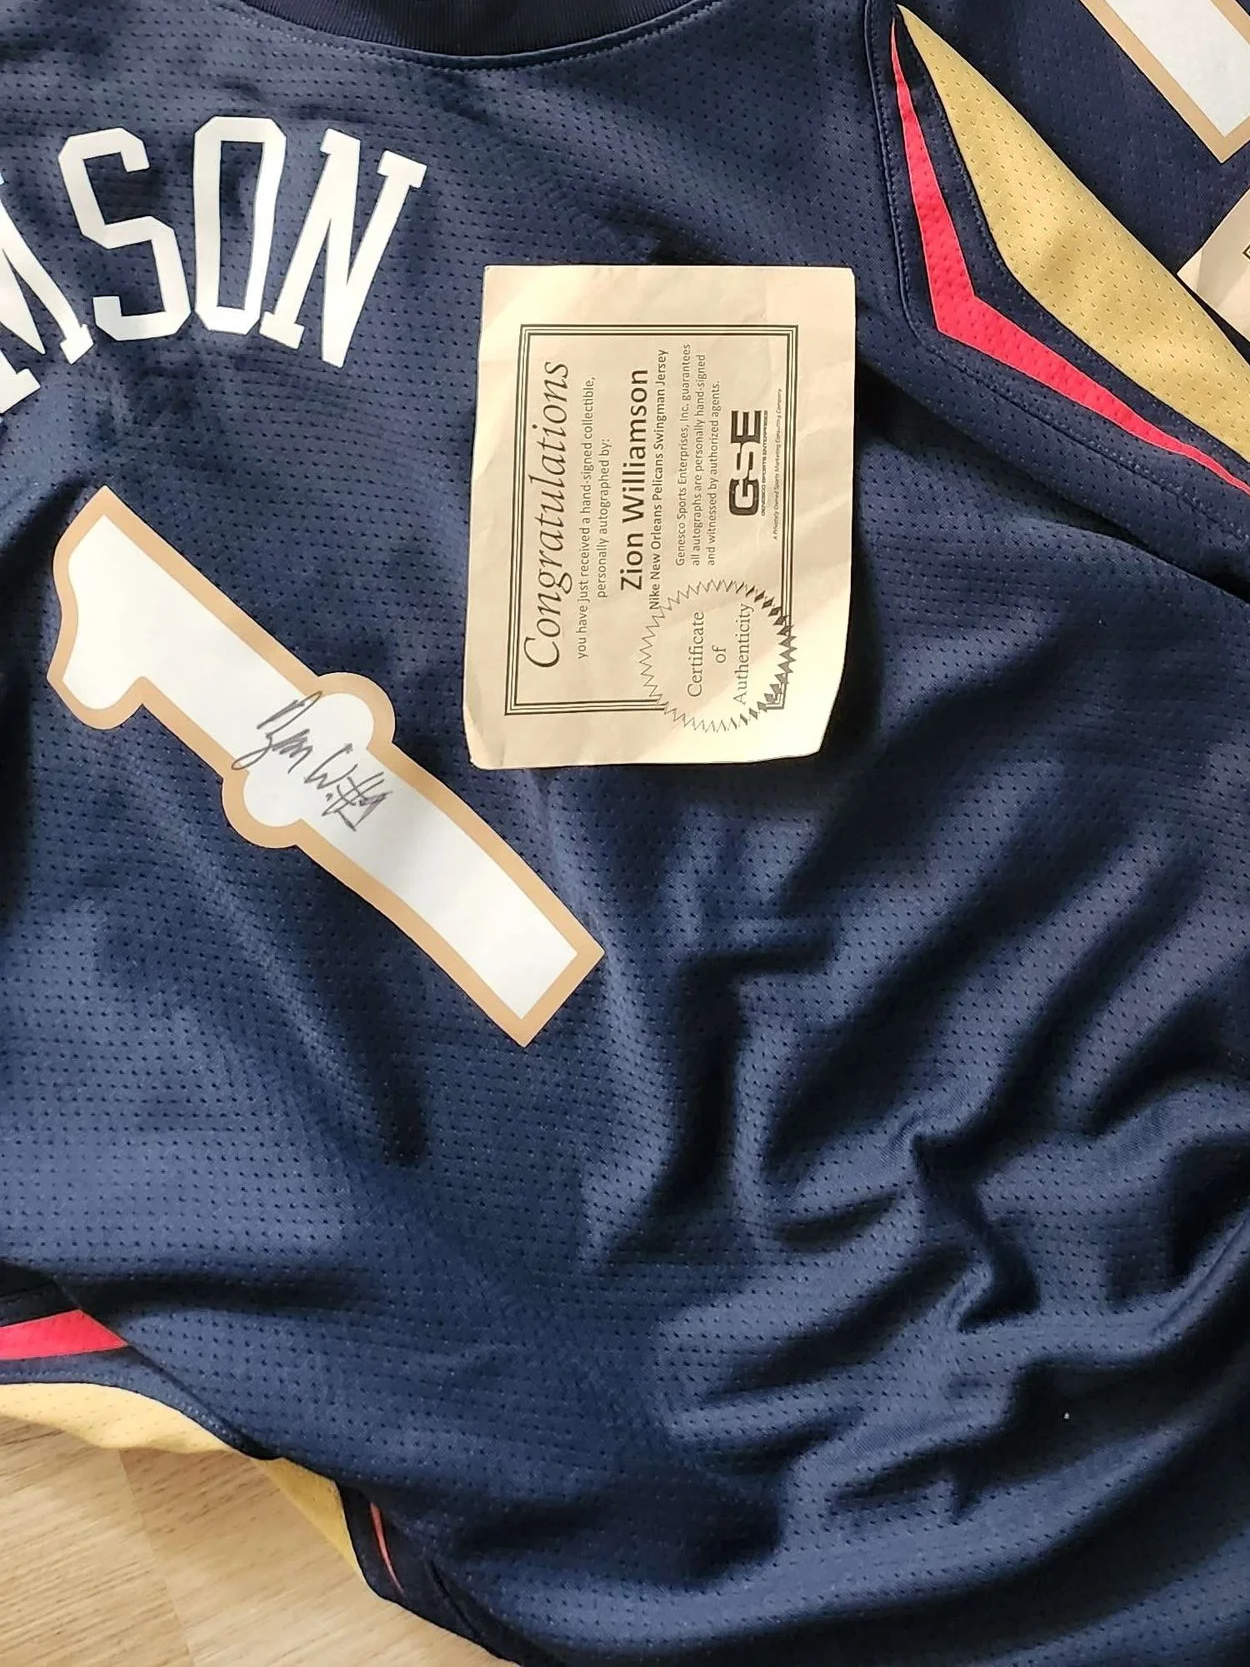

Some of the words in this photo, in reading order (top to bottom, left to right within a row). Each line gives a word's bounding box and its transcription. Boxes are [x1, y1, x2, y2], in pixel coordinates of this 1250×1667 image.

[654, 349, 669, 386] Jersey
[681, 344, 692, 401] guarantees
[693, 354, 708, 417] hand-signed
[581, 376, 596, 440] collectible,
[653, 388, 668, 451] Swingman
[679, 403, 690, 422] Inc.
[711, 381, 722, 418] agents.
[598, 439, 613, 456] by:
[621, 370, 648, 524] Williamson
[677, 424, 691, 485] Enterprises,
[693, 419, 706, 472] personally
[707, 420, 720, 476] authorized
[579, 442, 595, 514] hand-signed
[597, 460, 612, 535] autographed
[651, 453, 664, 501] Pelicans
[694, 474, 703, 492] are
[707, 477, 719, 490] by
[523, 361, 573, 668] Congratulations
[650, 504, 663, 550] Orleans
[676, 487, 688, 520] Sports
[691, 493, 704, 552] autographs
[706, 492, 718, 544] witnessed
[578, 527, 591, 577] received
[596, 537, 610, 598] personally
[619, 533, 644, 591] Zion
[649, 553, 661, 580] New
[675, 522, 686, 567] Genesco
[689, 554, 700, 566] all
[705, 546, 716, 566] and
[576, 580, 591, 603] just
[648, 583, 662, 610] Nike
[575, 605, 589, 634] have
[577, 637, 589, 660] you
[686, 611, 705, 698] Certificate
[711, 644, 727, 664] of
[733, 602, 755, 705] Authenticity
[47, 485, 605, 1047] 1
